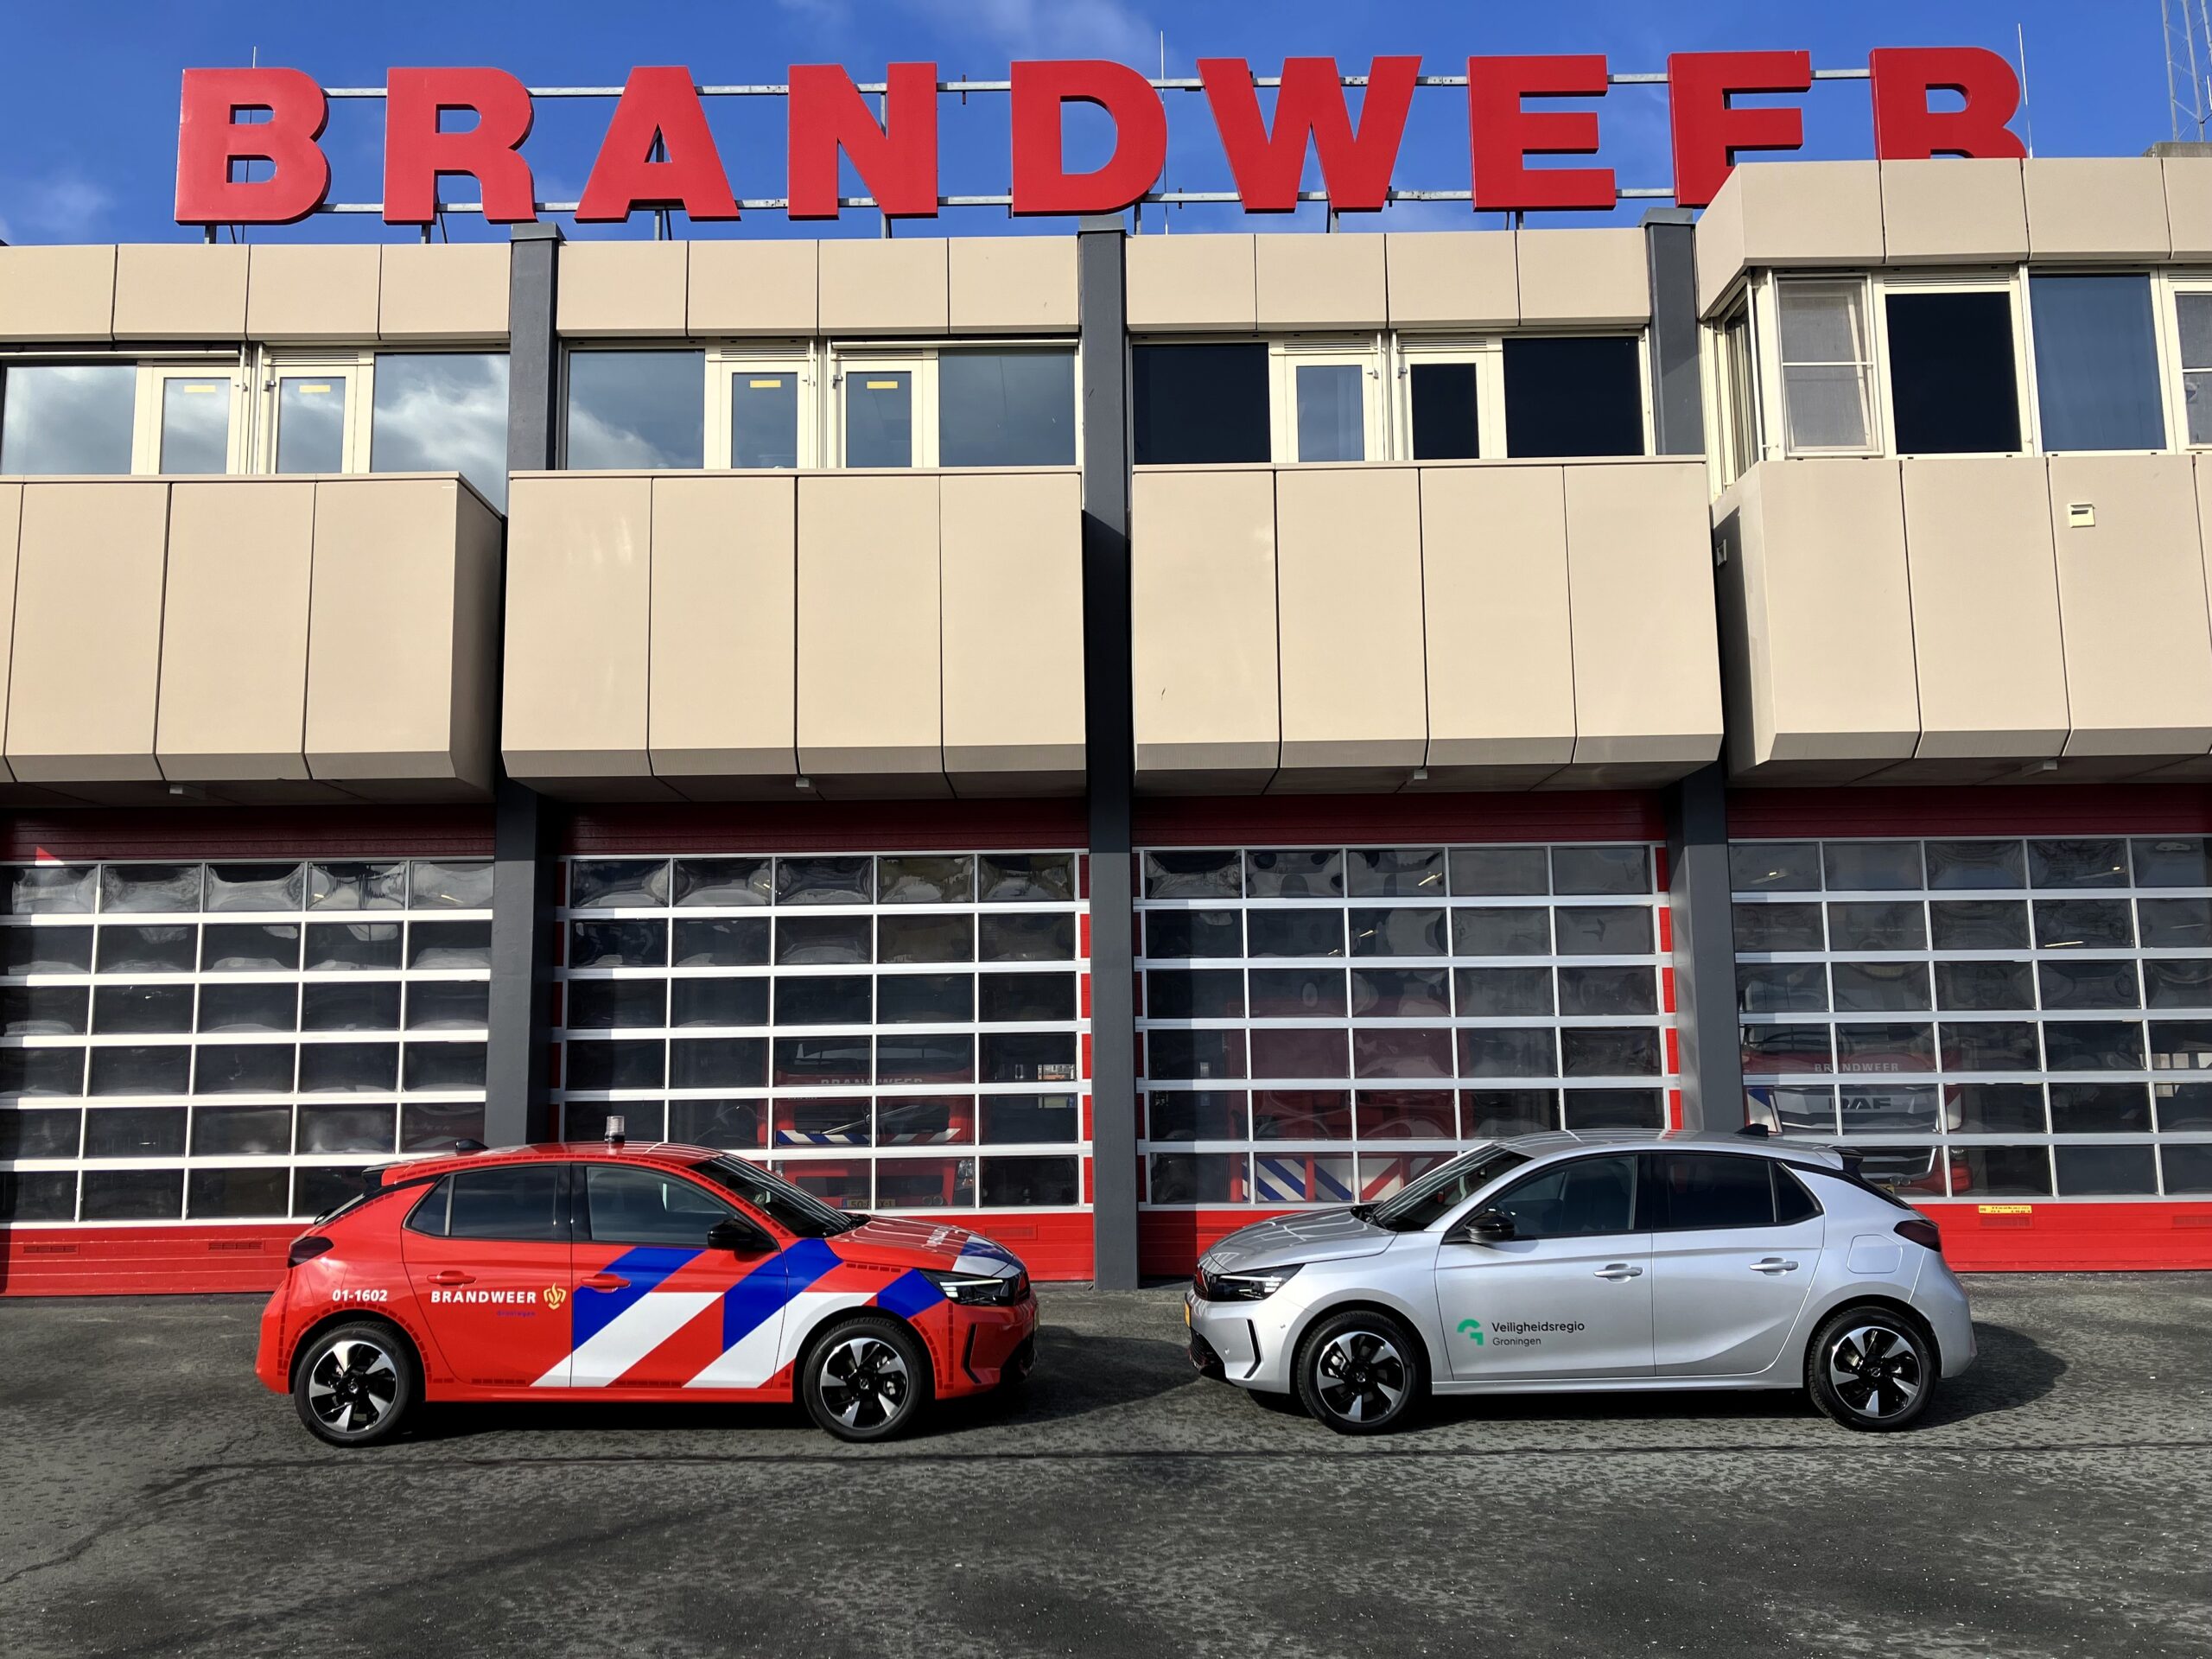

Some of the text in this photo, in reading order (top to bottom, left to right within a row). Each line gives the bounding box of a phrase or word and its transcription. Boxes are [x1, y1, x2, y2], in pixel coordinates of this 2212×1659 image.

[175, 47, 2029, 226] BRANDWEER
[1815, 1063, 1899, 1071] BRNDWEER
[1828, 1097, 1891, 1109] DAF
[333, 1289, 387, 1302] 01-1602
[431, 1291, 536, 1304] BRANDWEER
[1491, 1321, 1585, 1334] Veiligheidsregio
[1492, 1337, 1541, 1347] Groningen
